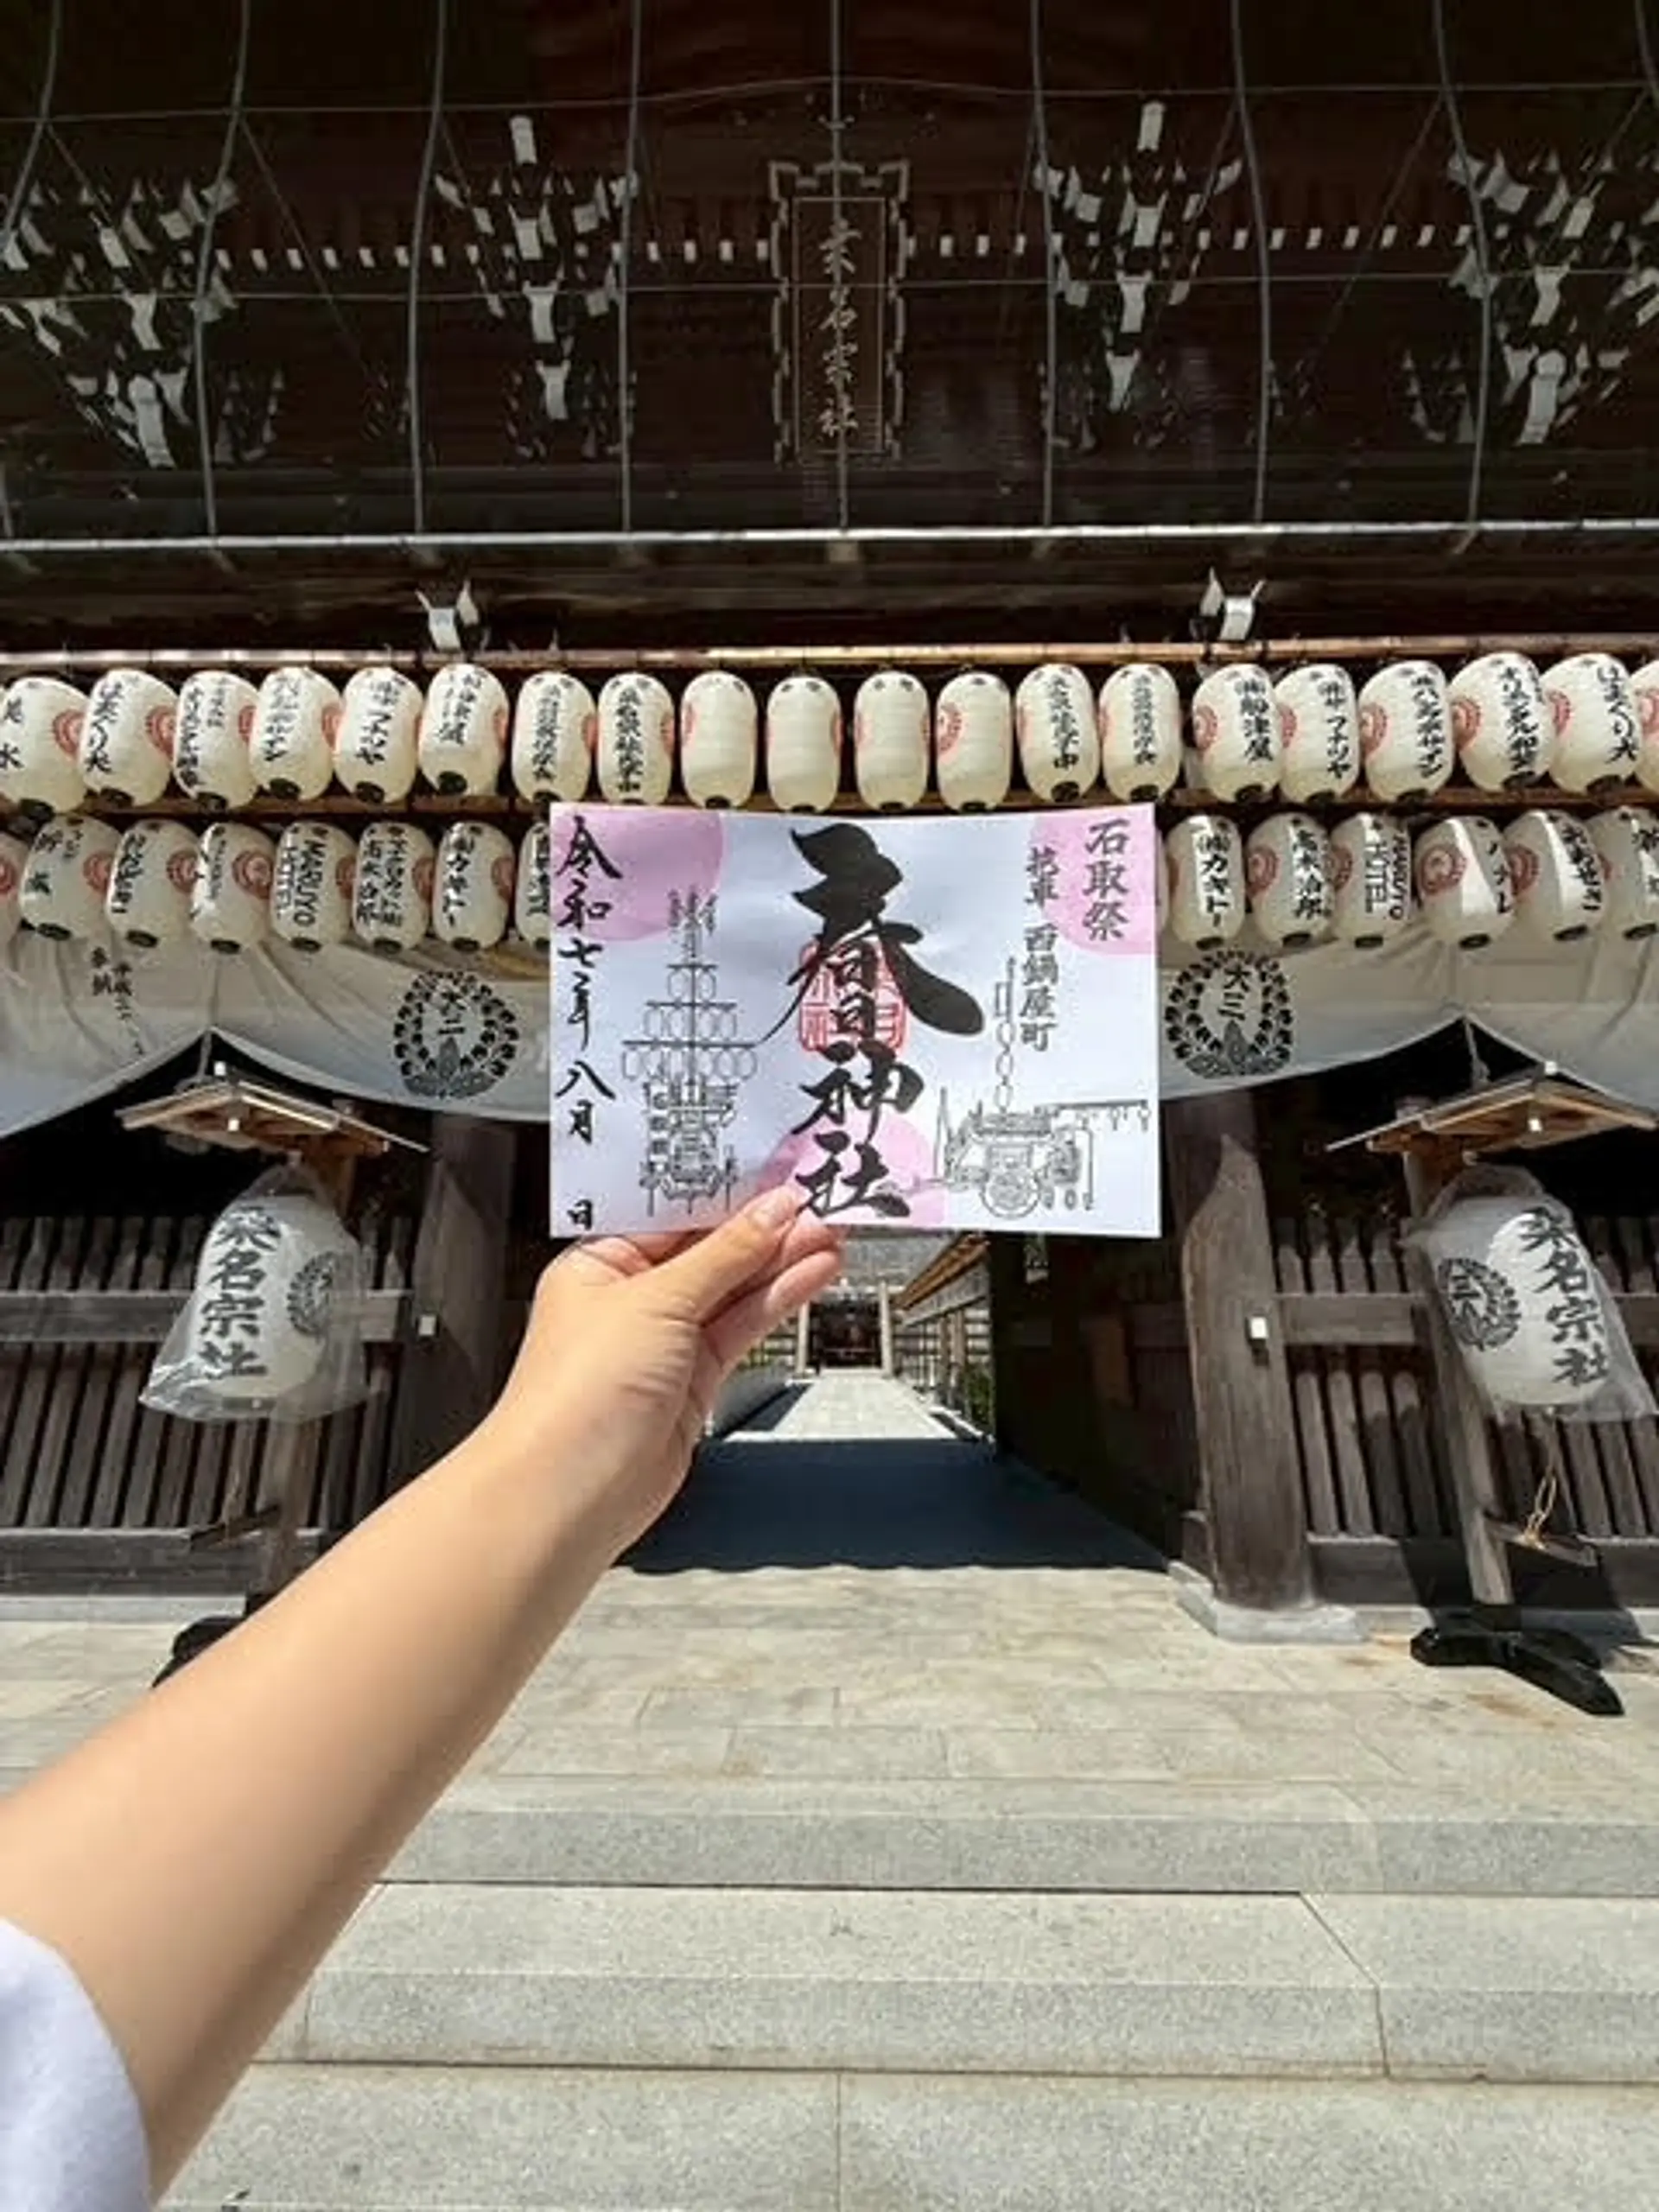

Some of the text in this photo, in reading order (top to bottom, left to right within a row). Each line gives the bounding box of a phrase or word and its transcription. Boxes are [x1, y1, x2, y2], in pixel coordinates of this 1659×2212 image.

[293, 839, 327, 927] MARUYO
[1082, 817, 1130, 942] 石取祭
[1364, 841, 1389, 914] HOTEL
[555, 814, 624, 1231] 令和七年八月 日
[764, 823, 984, 1218] 春日神社
[1019, 923, 1059, 1052] 西鍋屋町
[199, 1205, 283, 1382] 桑名宗社
[1514, 1206, 1610, 1388] 桑名宗社
